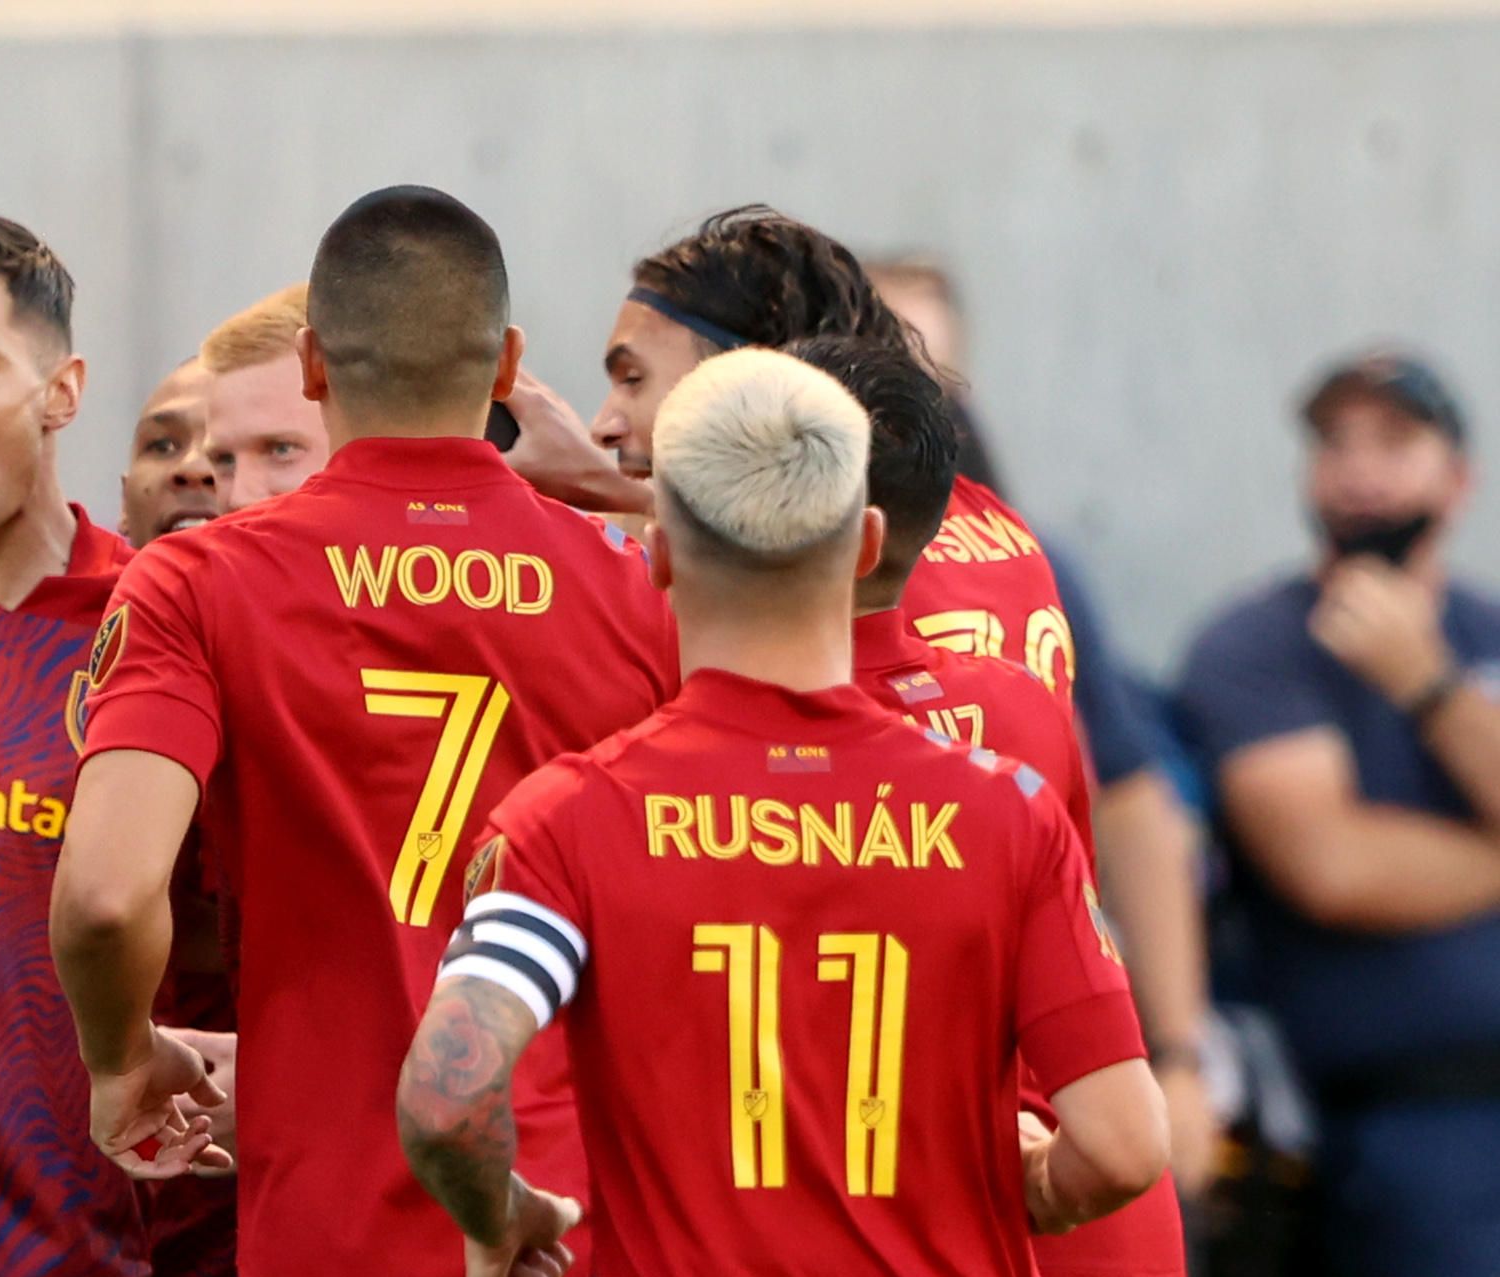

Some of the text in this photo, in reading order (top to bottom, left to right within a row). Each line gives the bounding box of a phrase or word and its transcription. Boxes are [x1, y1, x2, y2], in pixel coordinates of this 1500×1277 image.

[407, 501, 466, 513] AS ONE
[324, 544, 554, 615] WOOD
[767, 746, 829, 758] AS ONE
[360, 668, 511, 927] 7
[644, 783, 964, 870] RUSNÁK
[692, 923, 909, 1197] 11
